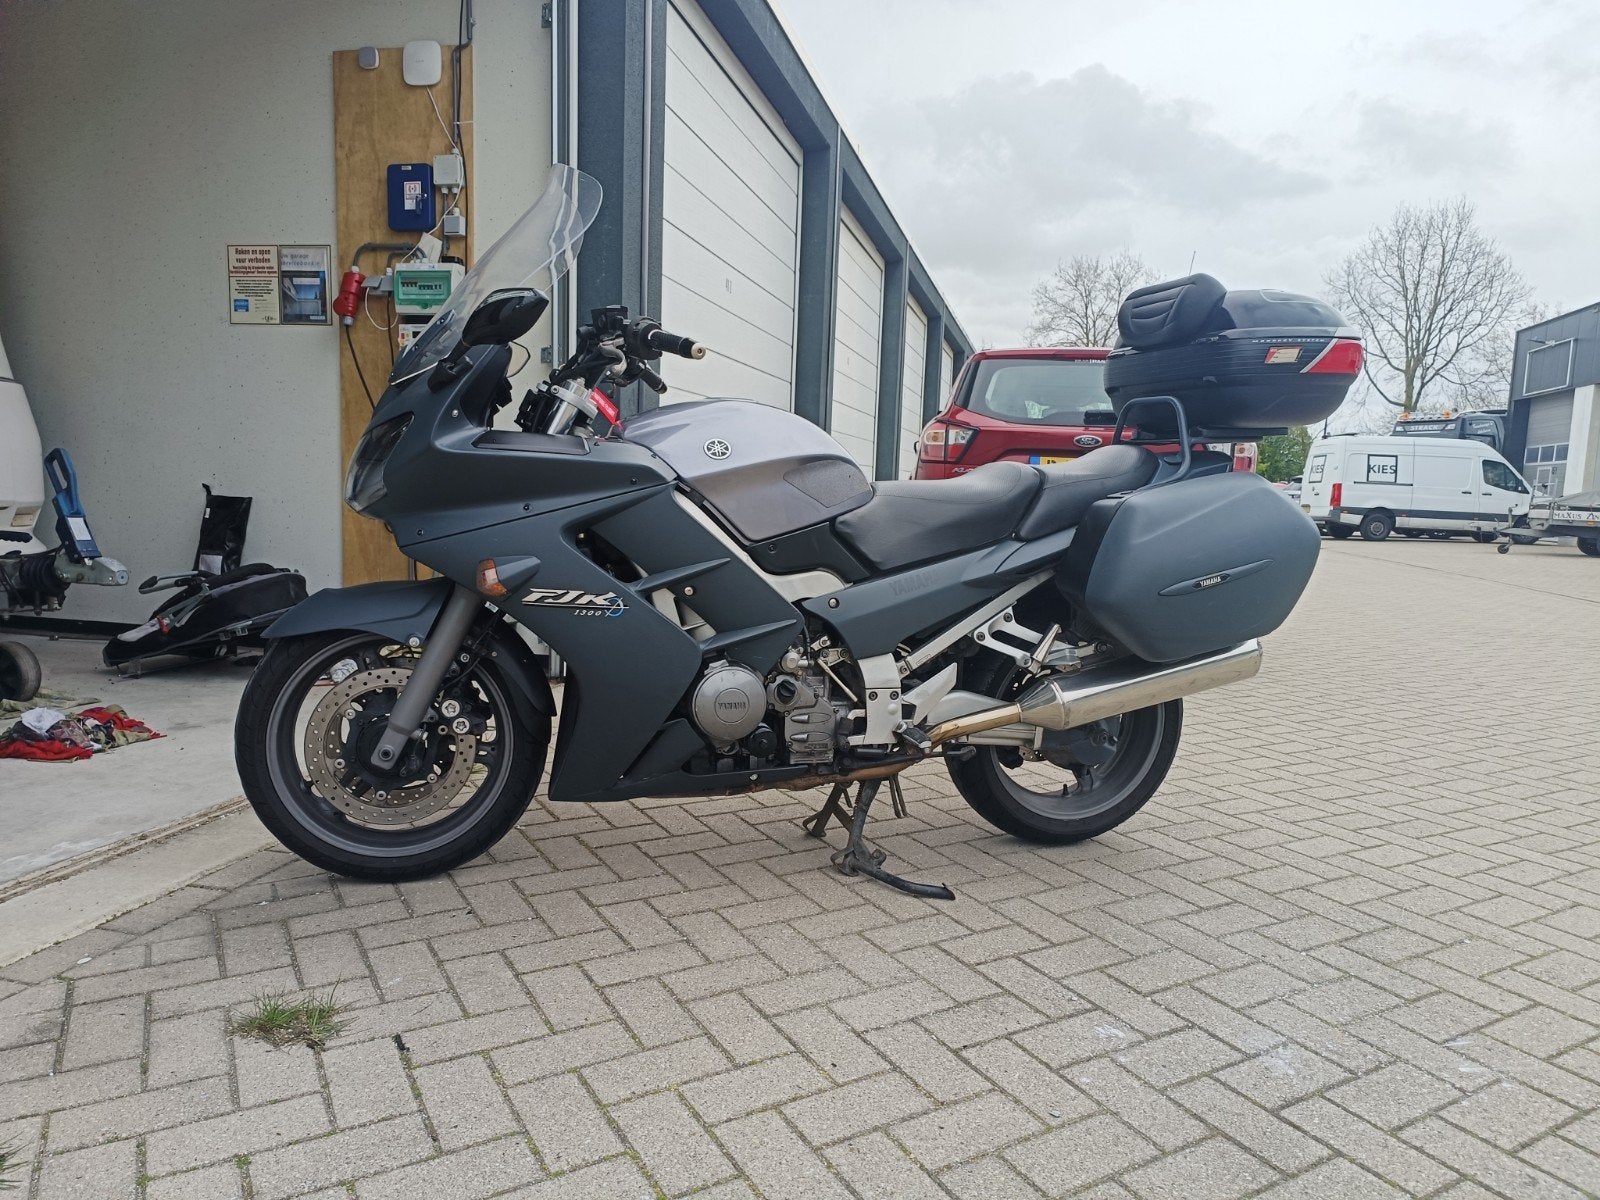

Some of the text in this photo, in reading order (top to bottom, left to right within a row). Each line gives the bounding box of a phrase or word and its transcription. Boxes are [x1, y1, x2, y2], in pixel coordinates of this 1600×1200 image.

[1368, 464, 1397, 475] KIES
[889, 569, 942, 596] YAMAHA
[1200, 576, 1222, 588] YAMAHA
[717, 702, 747, 710] YAMAHA
